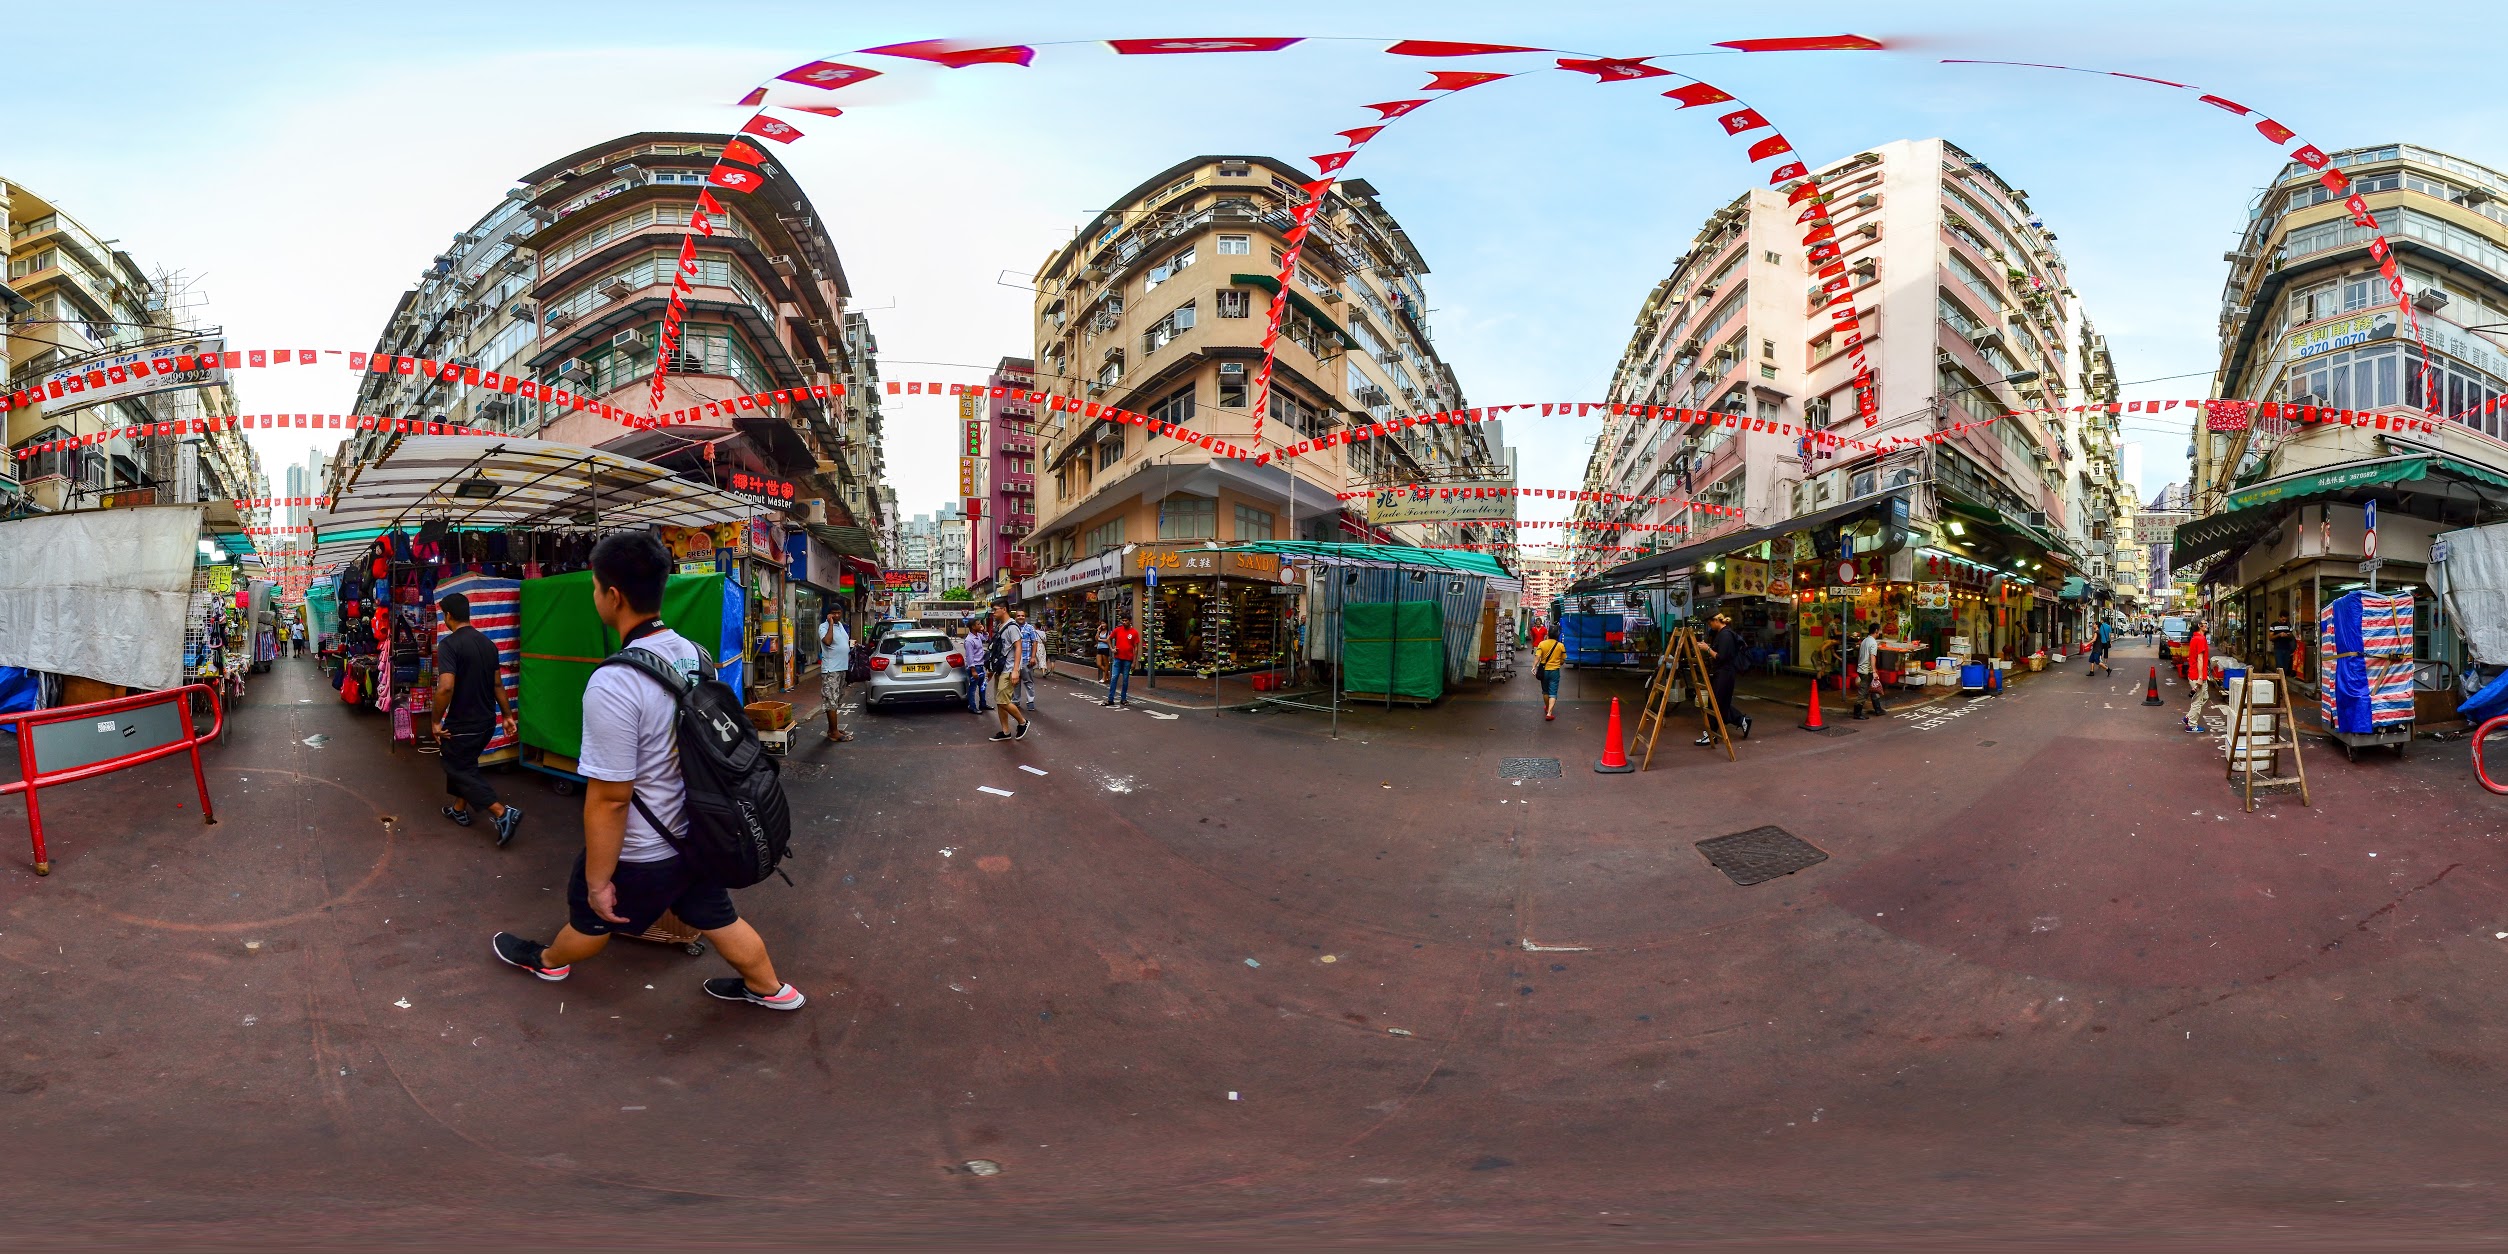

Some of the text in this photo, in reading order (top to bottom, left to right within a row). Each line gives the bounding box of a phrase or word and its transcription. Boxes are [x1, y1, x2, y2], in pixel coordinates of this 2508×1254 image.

[2291, 317, 2373, 349] 英利財務
[2301, 332, 2366, 357] 9270 0070
[767, 496, 793, 509] Master
[1404, 507, 1449, 517] Forever
[686, 549, 713, 558] FRESH
[1136, 550, 1212, 570] 新地 皮鞋
[1237, 553, 1278, 573] SANDY
